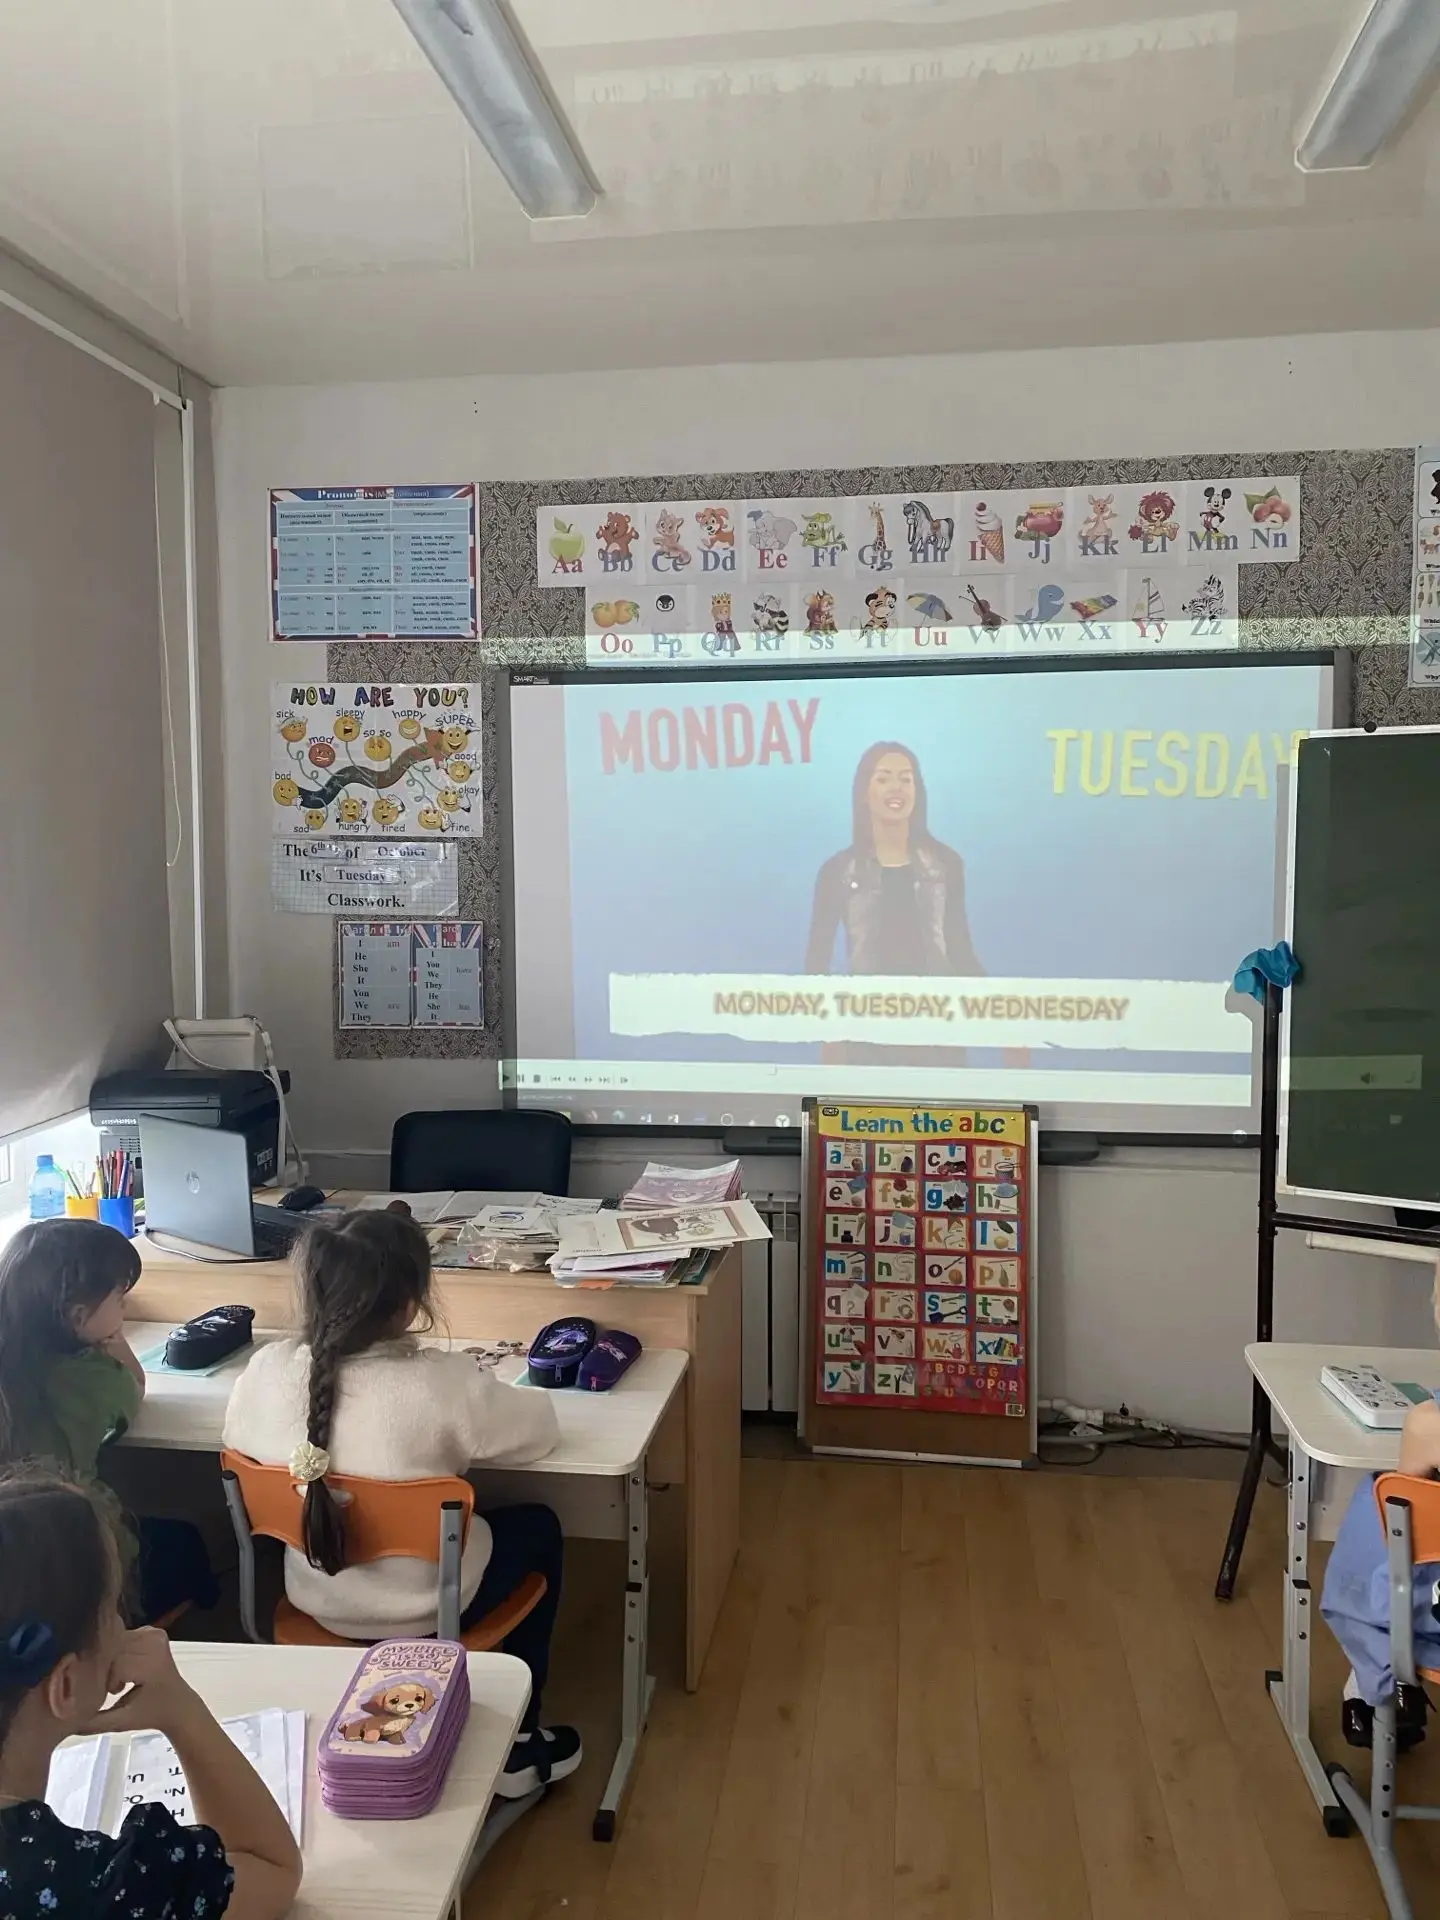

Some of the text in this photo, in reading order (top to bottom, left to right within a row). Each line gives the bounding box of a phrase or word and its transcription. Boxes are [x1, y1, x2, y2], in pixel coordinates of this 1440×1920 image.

[552, 554, 584, 574] Aa
[602, 551, 633, 573] Bb
[701, 549, 737, 572] Dd
[758, 548, 788, 569] Ee
[811, 546, 841, 568] Ff
[858, 544, 894, 571] Gg
[909, 540, 949, 563] Hh
[968, 541, 989, 561] Ii
[1028, 539, 1051, 565] Jj
[1081, 535, 1120, 555] Kk
[1141, 532, 1168, 554] Ll
[1188, 530, 1239, 551] Mm
[1250, 528, 1288, 549] Nn
[600, 632, 634, 654] Oo
[653, 631, 683, 658] Pp
[701, 631, 736, 658] Qq
[755, 631, 785, 652] Rr
[809, 632, 835, 651] Ss
[913, 626, 949, 647] Uu
[968, 624, 1001, 645] Vv
[1015, 621, 1066, 643] Ww
[1078, 620, 1113, 640] Xx
[1133, 618, 1169, 644] Yy
[1190, 614, 1224, 636] Zz
[290, 687, 469, 709] HOW ARE YOU?
[276, 709, 295, 718] sick
[336, 708, 366, 719] sleepy
[392, 709, 426, 721] happy
[436, 714, 474, 727] SUPER
[363, 729, 392, 738] so so
[598, 697, 821, 776] MONDAY
[308, 734, 335, 745] mad
[274, 771, 292, 780] bad
[458, 785, 480, 796] okay
[293, 824, 310, 834] sad
[338, 821, 371, 834] hungry
[381, 823, 406, 833] tired
[283, 843, 309, 857] The
[311, 842, 326, 855] 6th
[345, 846, 360, 859] of
[336, 869, 386, 882] Tuesday
[328, 893, 405, 908] Classwork.
[358, 940, 362, 948] I
[354, 952, 367, 961] He
[352, 964, 369, 973] She
[426, 961, 440, 969] You
[357, 976, 365, 985] It
[427, 971, 439, 979] We
[424, 981, 443, 990] They
[353, 989, 370, 998] You
[428, 992, 439, 1000] He
[354, 1001, 369, 1010] We
[426, 1003, 441, 1011] She
[713, 991, 1131, 1022] MONDAY, TUESDAY, WEDNESDAY
[351, 1012, 371, 1023] They
[431, 1013, 437, 1021] It
[841, 1110, 904, 1134] Learn
[910, 1112, 954, 1134] the
[959, 1112, 1006, 1134] abc
[830, 1146, 993, 1168] a b c d
[829, 1181, 993, 1209] e f g h
[832, 1216, 839, 1238] i
[879, 1218, 891, 1243] j
[927, 1220, 943, 1243] k
[827, 1258, 994, 1286] m n o p
[827, 1294, 841, 1315] q
[880, 1295, 891, 1313] r
[978, 1296, 992, 1317] t
[827, 1333, 992, 1355] u v w x
[826, 1371, 891, 1388] y z
[381, 1644, 457, 1656] MY LIFE
[379, 1659, 440, 1670] SWEET
